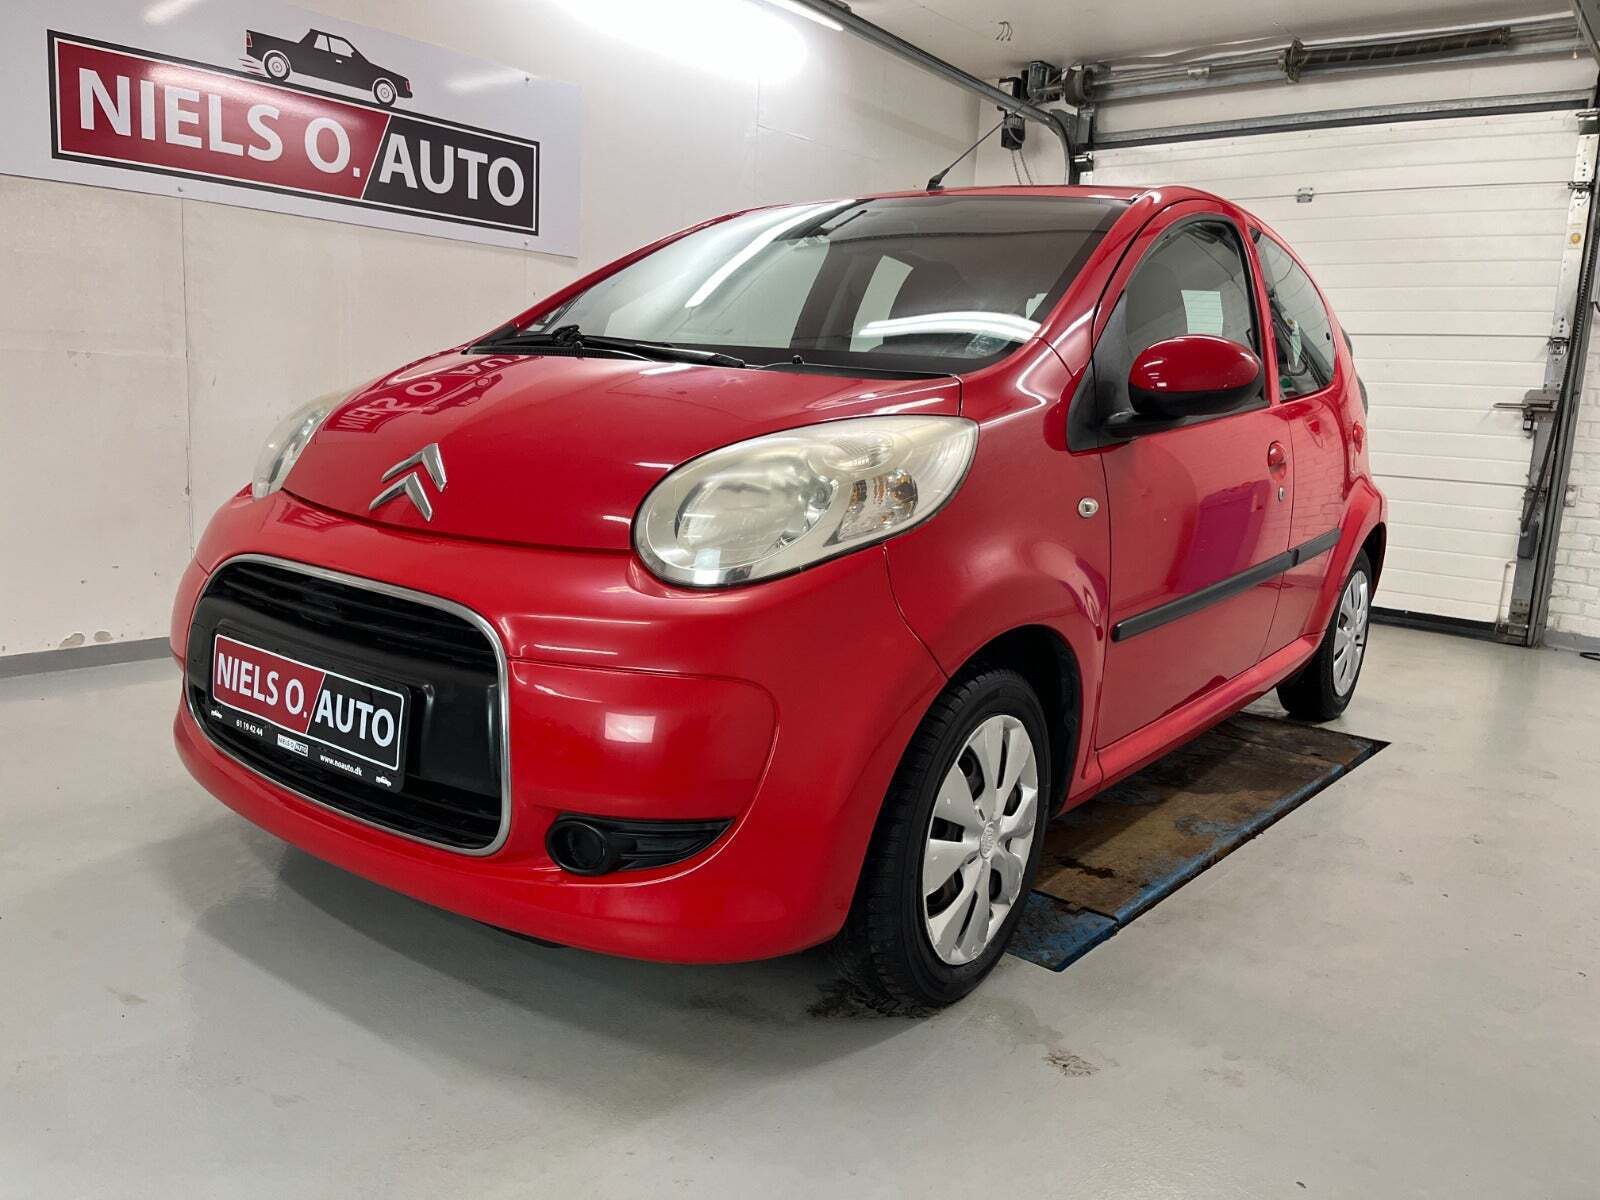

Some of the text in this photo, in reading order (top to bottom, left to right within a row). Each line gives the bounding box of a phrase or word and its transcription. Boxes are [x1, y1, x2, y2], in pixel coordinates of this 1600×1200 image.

[78, 67, 525, 207] NIELS O. AUTO
[217, 652, 395, 747] NIELS O. AUTO
[319, 754, 363, 776] www.noauto.dk
